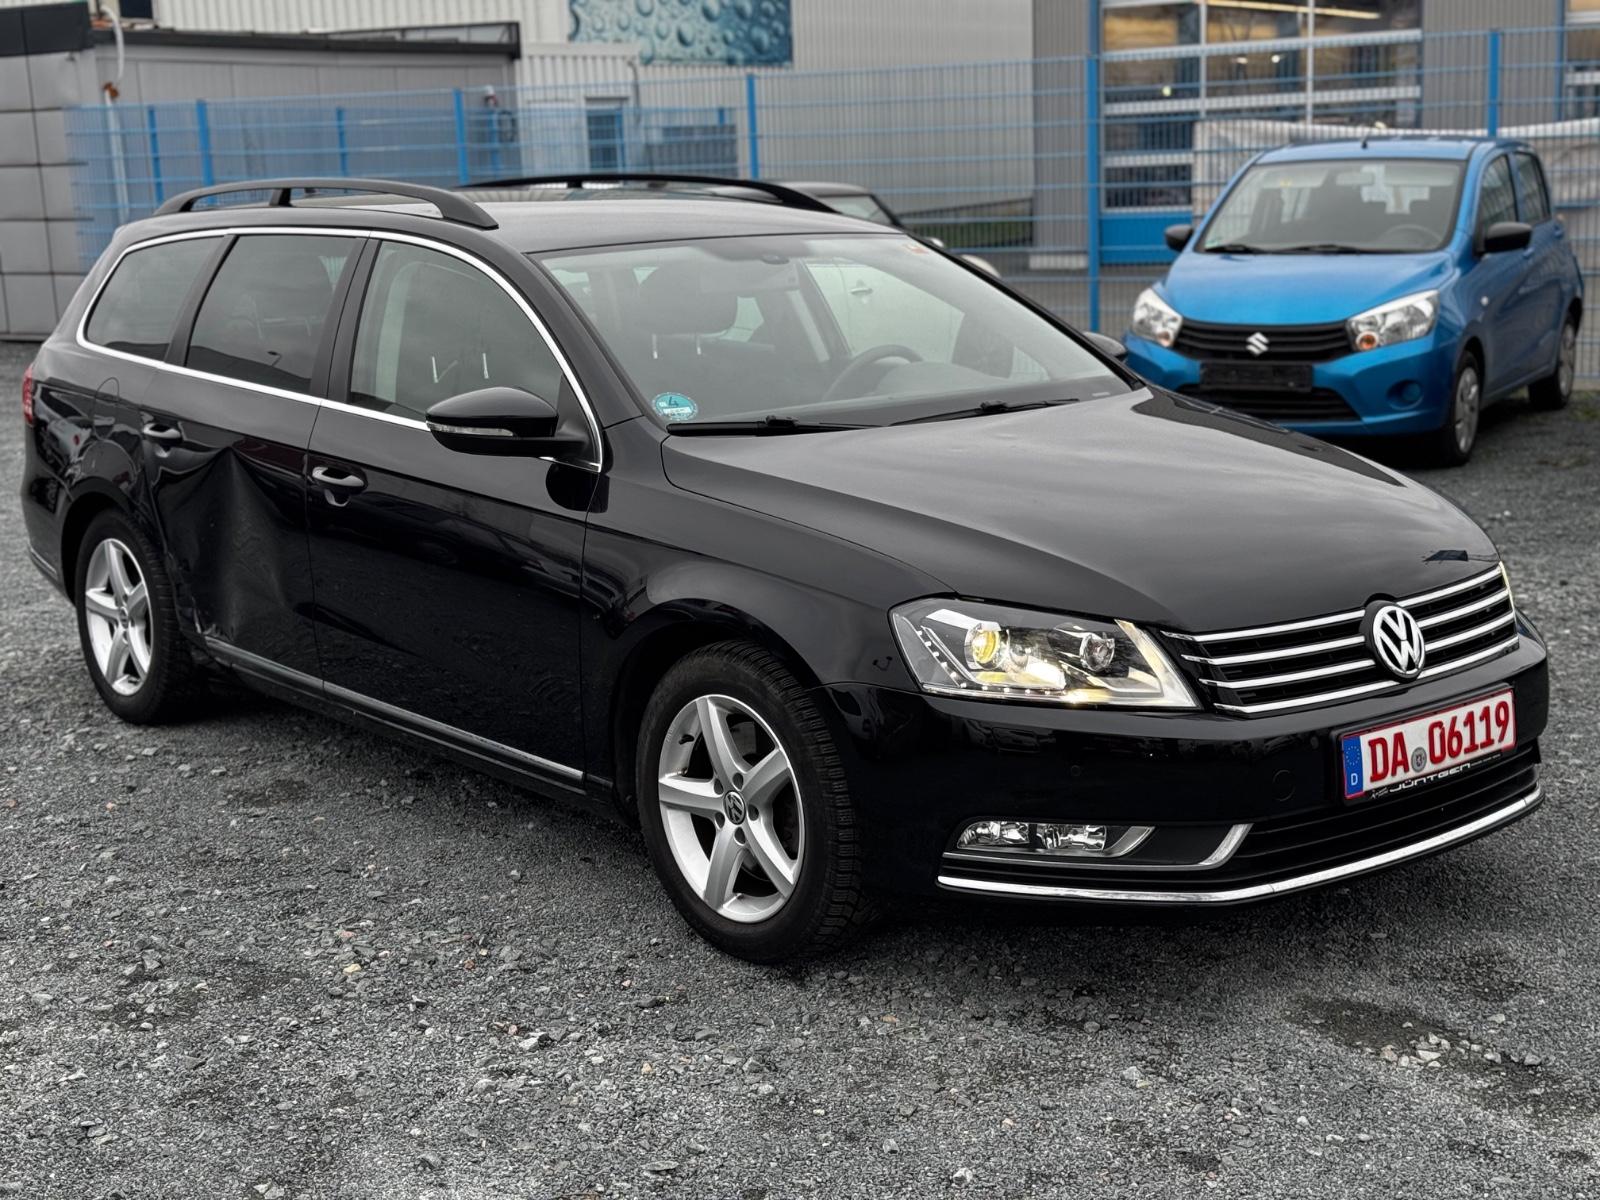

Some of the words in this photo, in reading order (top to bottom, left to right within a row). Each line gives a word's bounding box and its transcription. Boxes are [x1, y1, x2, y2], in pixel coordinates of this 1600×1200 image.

[1350, 772, 1359, 786] D
[1368, 731, 1410, 783] DA
[1428, 700, 1510, 765] 06119
